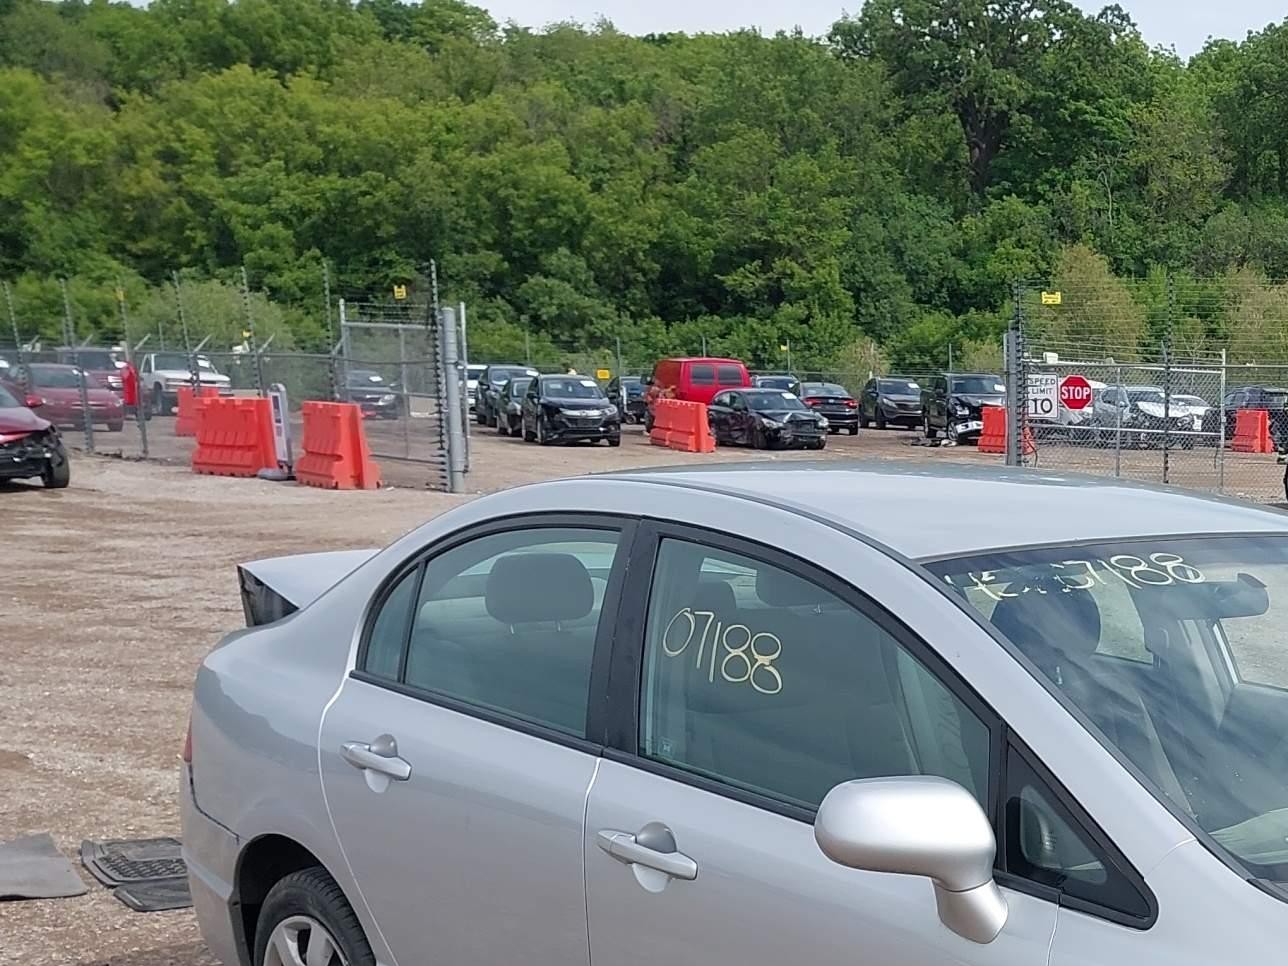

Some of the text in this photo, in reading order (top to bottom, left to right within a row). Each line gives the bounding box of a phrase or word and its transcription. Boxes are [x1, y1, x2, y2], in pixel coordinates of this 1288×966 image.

[1029, 377, 1056, 385] SPEED
[1031, 387, 1053, 395] LIMIT
[1061, 386, 1090, 400] STOP
[1029, 398, 1053, 414] 10
[662, 607, 783, 694] 07188
